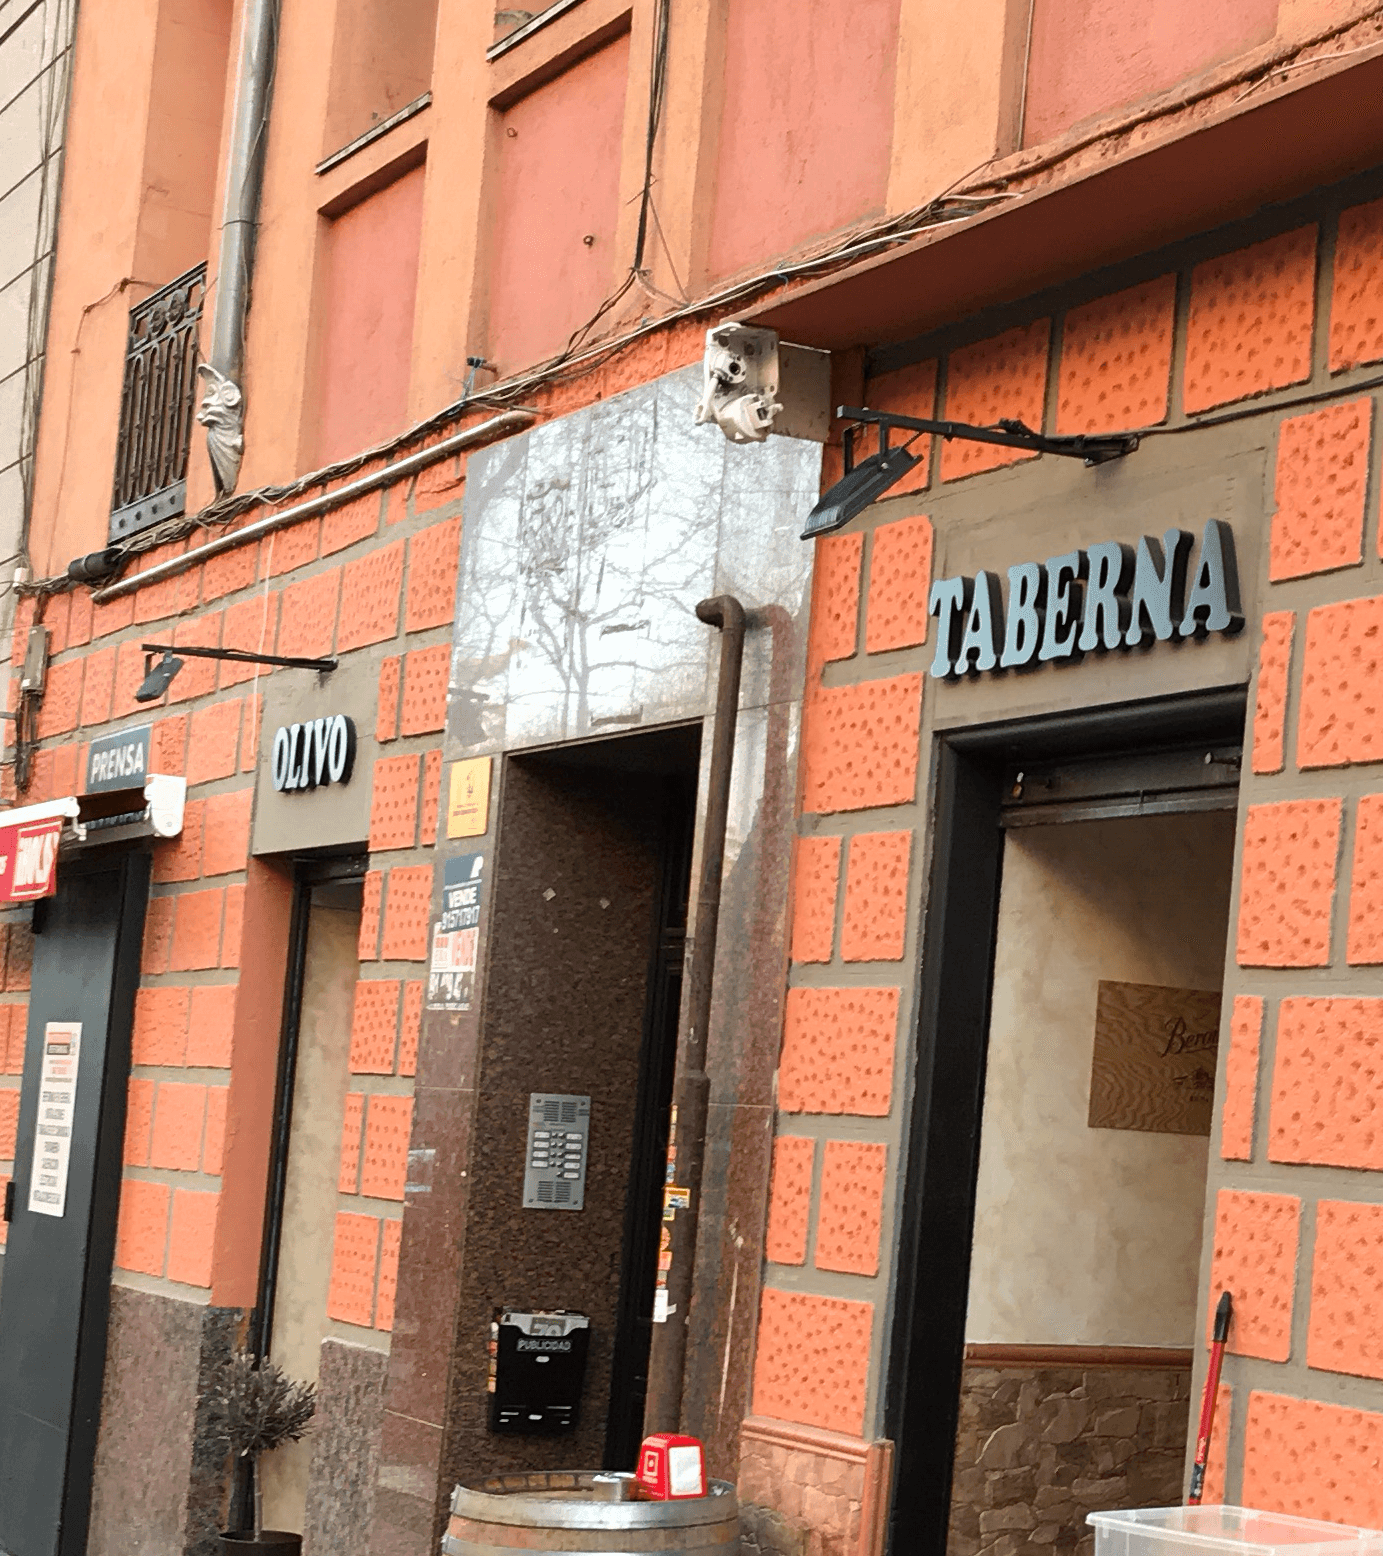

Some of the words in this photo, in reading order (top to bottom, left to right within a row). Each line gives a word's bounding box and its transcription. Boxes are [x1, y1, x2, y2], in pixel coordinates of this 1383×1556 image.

[929, 518, 1244, 682] TABERNA
[90, 742, 144, 784] PRENSA
[271, 714, 356, 793] OLIVO
[448, 886, 477, 908] VENDE
[518, 1339, 572, 1352] PUBLICIDAD
